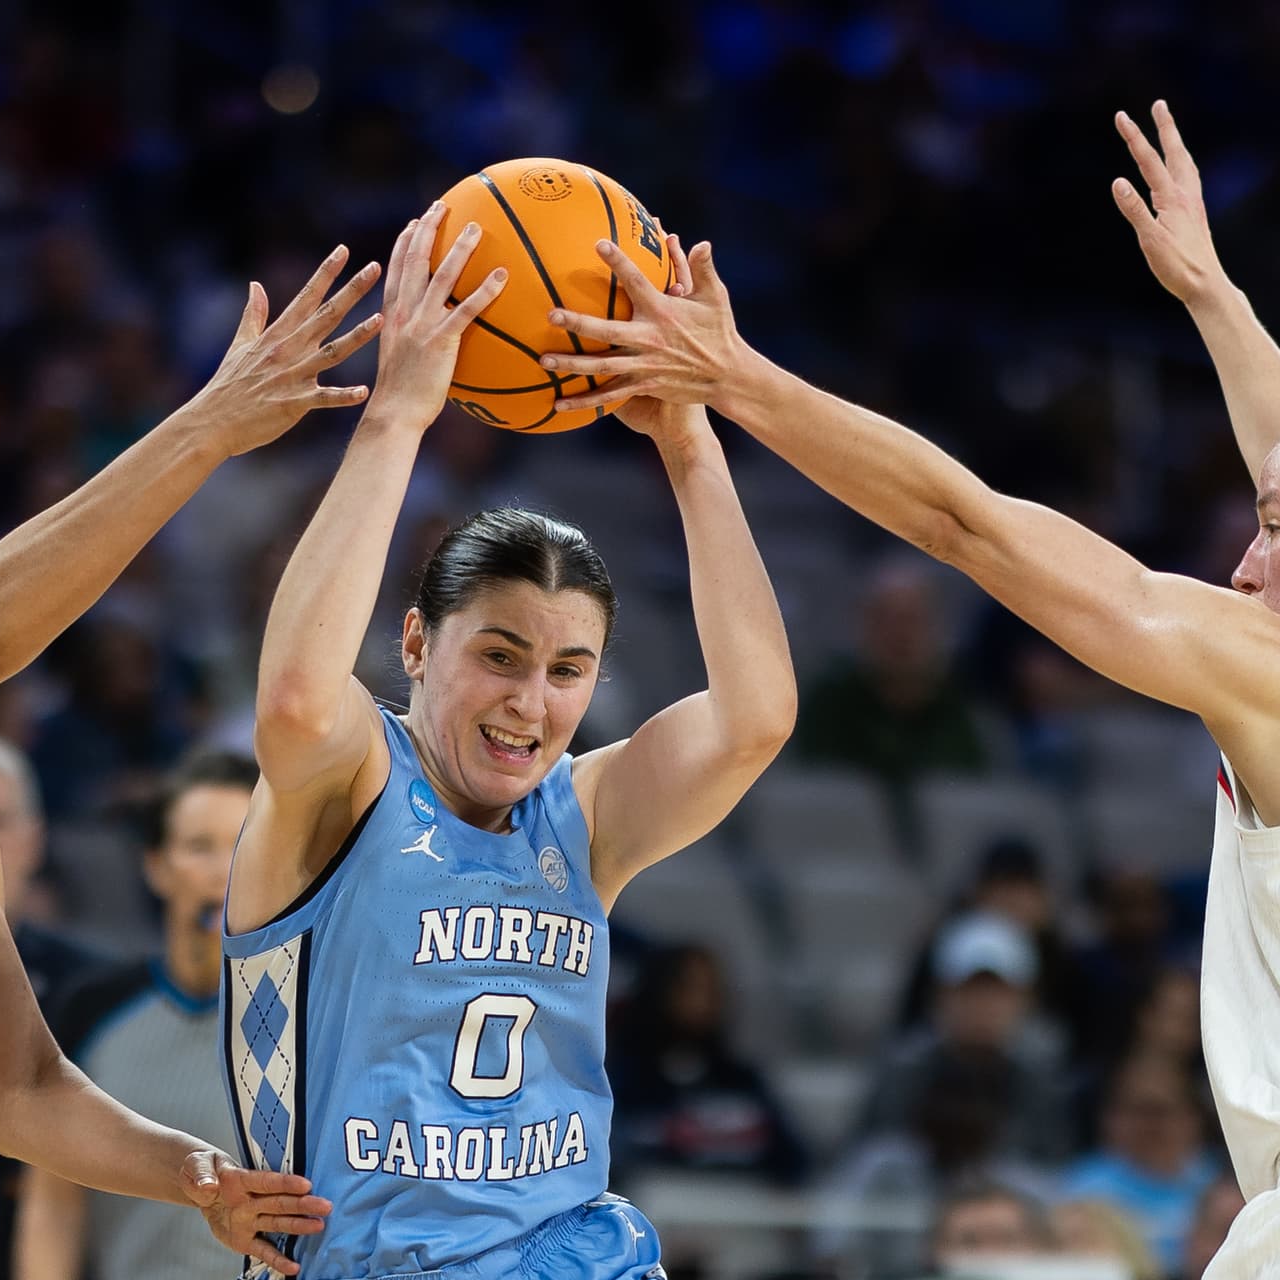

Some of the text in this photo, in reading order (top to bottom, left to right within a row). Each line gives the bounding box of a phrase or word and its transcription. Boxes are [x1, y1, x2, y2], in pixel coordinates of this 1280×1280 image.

[413, 906, 594, 976] NORTH
[449, 992, 539, 1100] 0
[343, 1111, 589, 1182] CAROLINA
